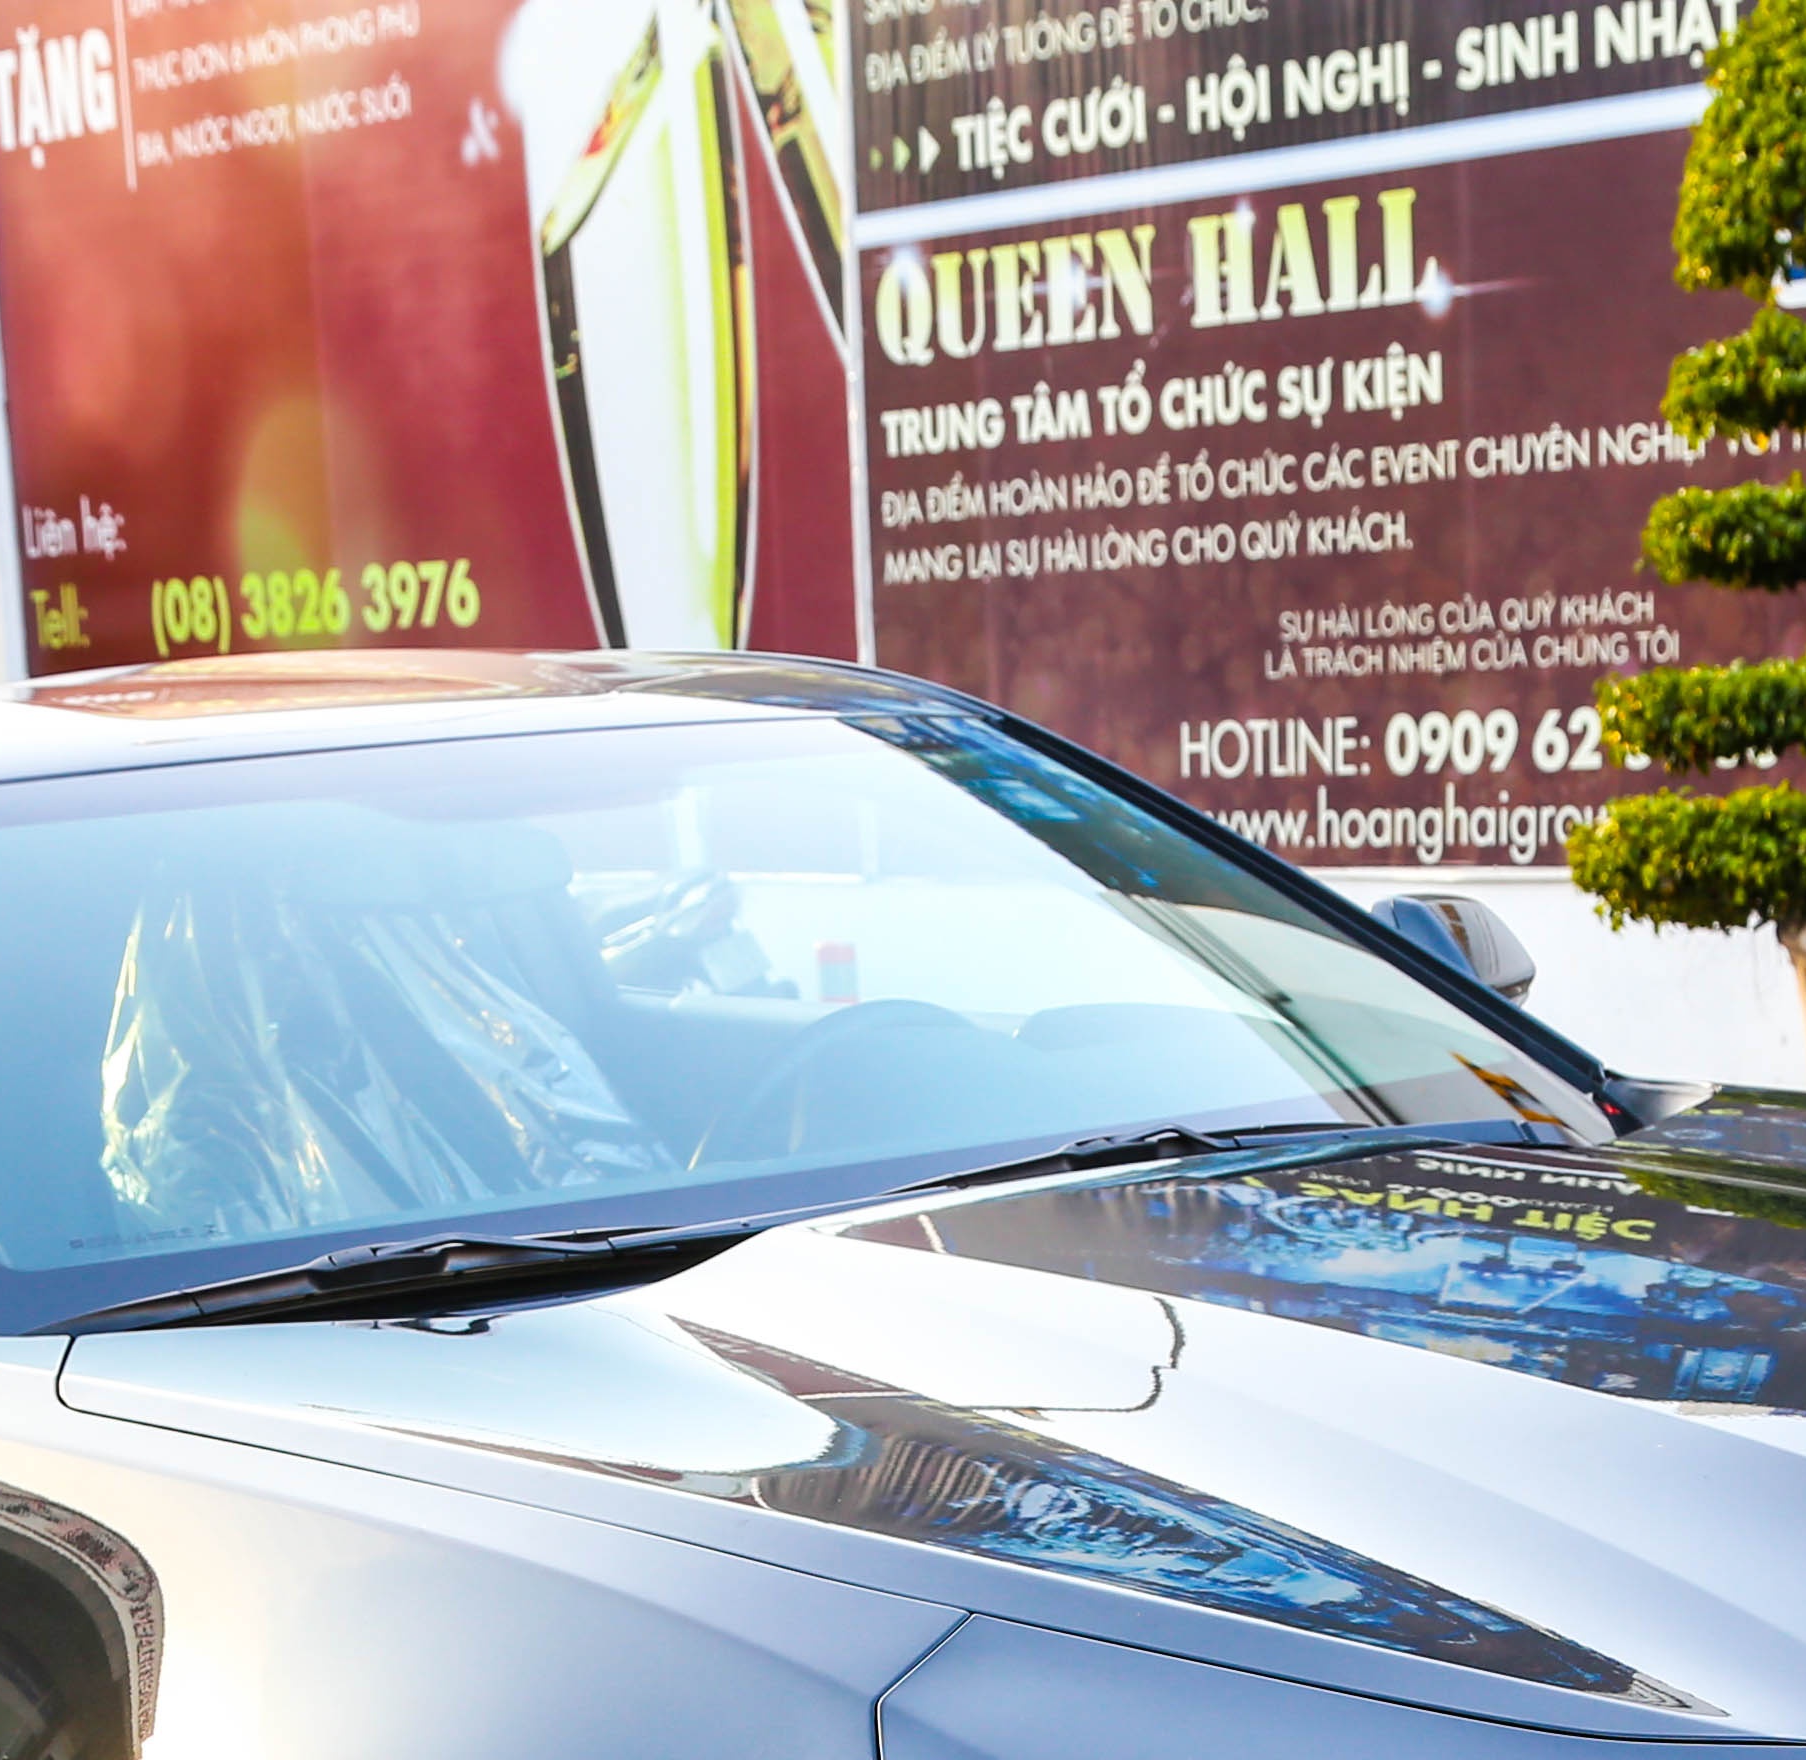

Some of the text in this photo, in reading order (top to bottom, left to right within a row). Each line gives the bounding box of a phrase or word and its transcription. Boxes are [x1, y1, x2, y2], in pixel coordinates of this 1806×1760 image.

[950, 95, 1034, 180] TIỆC
[1041, 74, 1147, 158] CƯỚI
[1157, 104, 1176, 123] -
[1185, 53, 1271, 142] HỘI
[1283, 39, 1410, 117] NGHỊ
[1422, 58, 1442, 80] -
[1455, 9, 1579, 91] SINH
[875, 187, 1439, 366] QUEEN HALL
[880, 341, 1443, 457] TRUNG TÂM TỔ CHỨC SỰ KIỆN
[989, 468, 1068, 516] HOÀN
[1302, 441, 1366, 493] CÁC
[1370, 439, 1461, 487] EVENT
[1465, 421, 1591, 478] CHUYÊN
[882, 543, 964, 586] MANG
[1092, 523, 1169, 570] LÒNG
[1171, 522, 1236, 565] CHO
[1307, 505, 1414, 556] KHÁCH.
[151, 575, 232, 658] (08)
[241, 567, 351, 640] 3826
[361, 558, 480, 633] 3976
[1635, 624, 1681, 664] TÔI
[1179, 705, 1603, 779] HOTLINE: 0909 62
